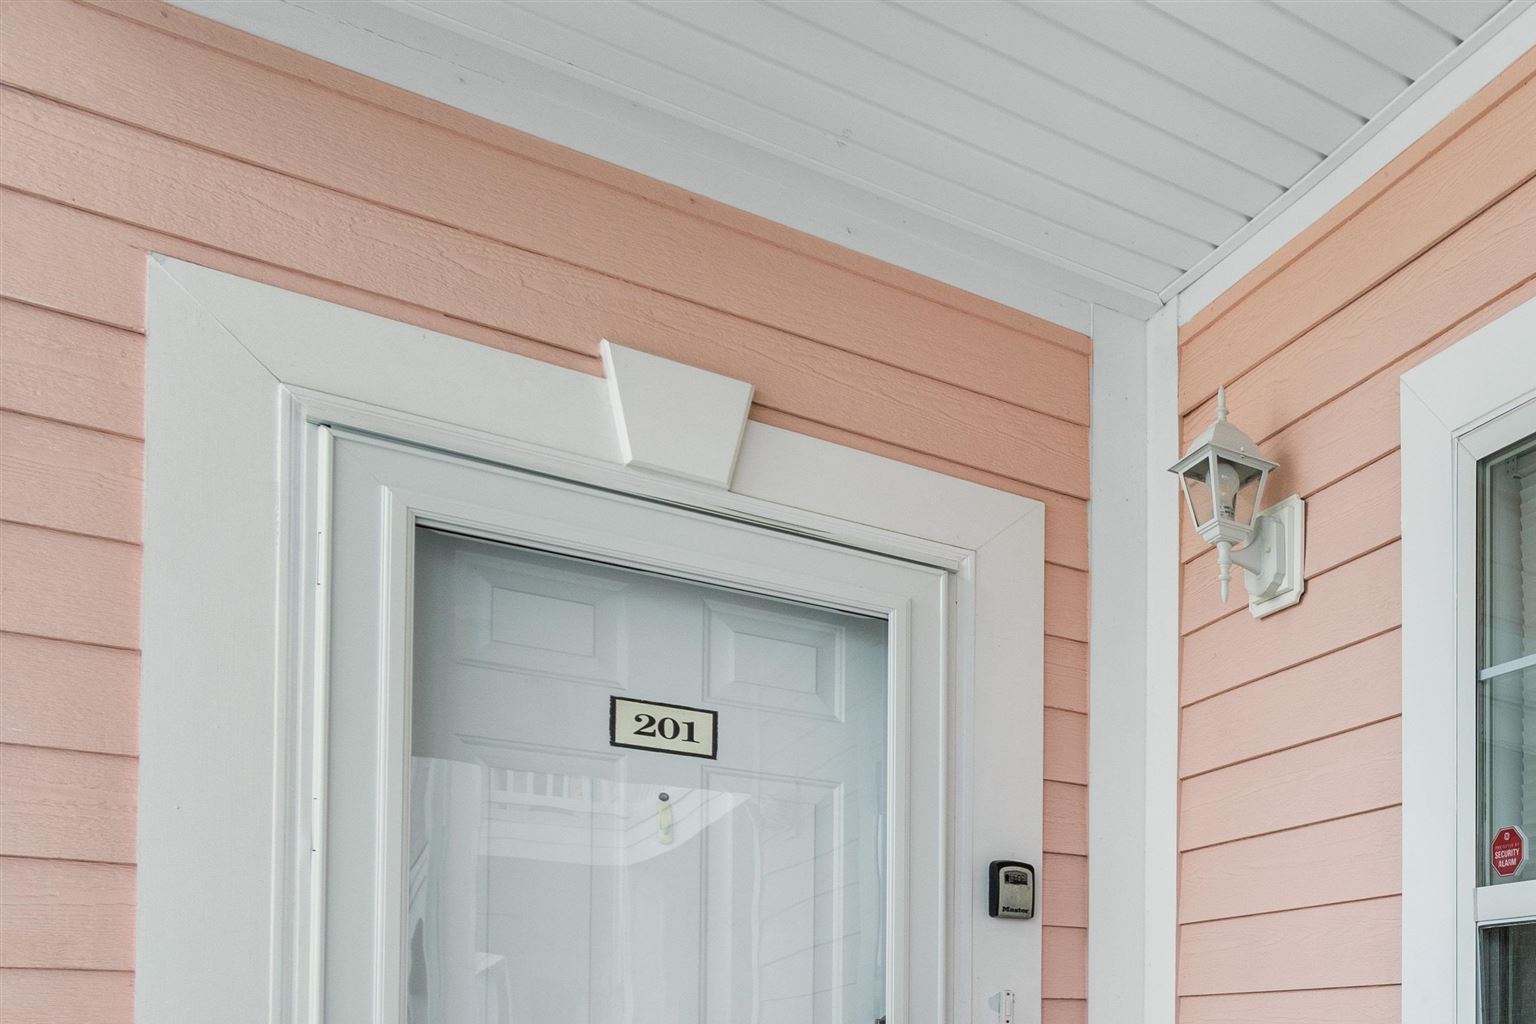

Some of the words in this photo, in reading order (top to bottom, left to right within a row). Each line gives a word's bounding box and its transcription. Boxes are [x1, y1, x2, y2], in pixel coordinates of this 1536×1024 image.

[633, 713, 700, 744] 201
[1494, 848, 1520, 859] SECURITY
[1498, 858, 1517, 868] ALARM
